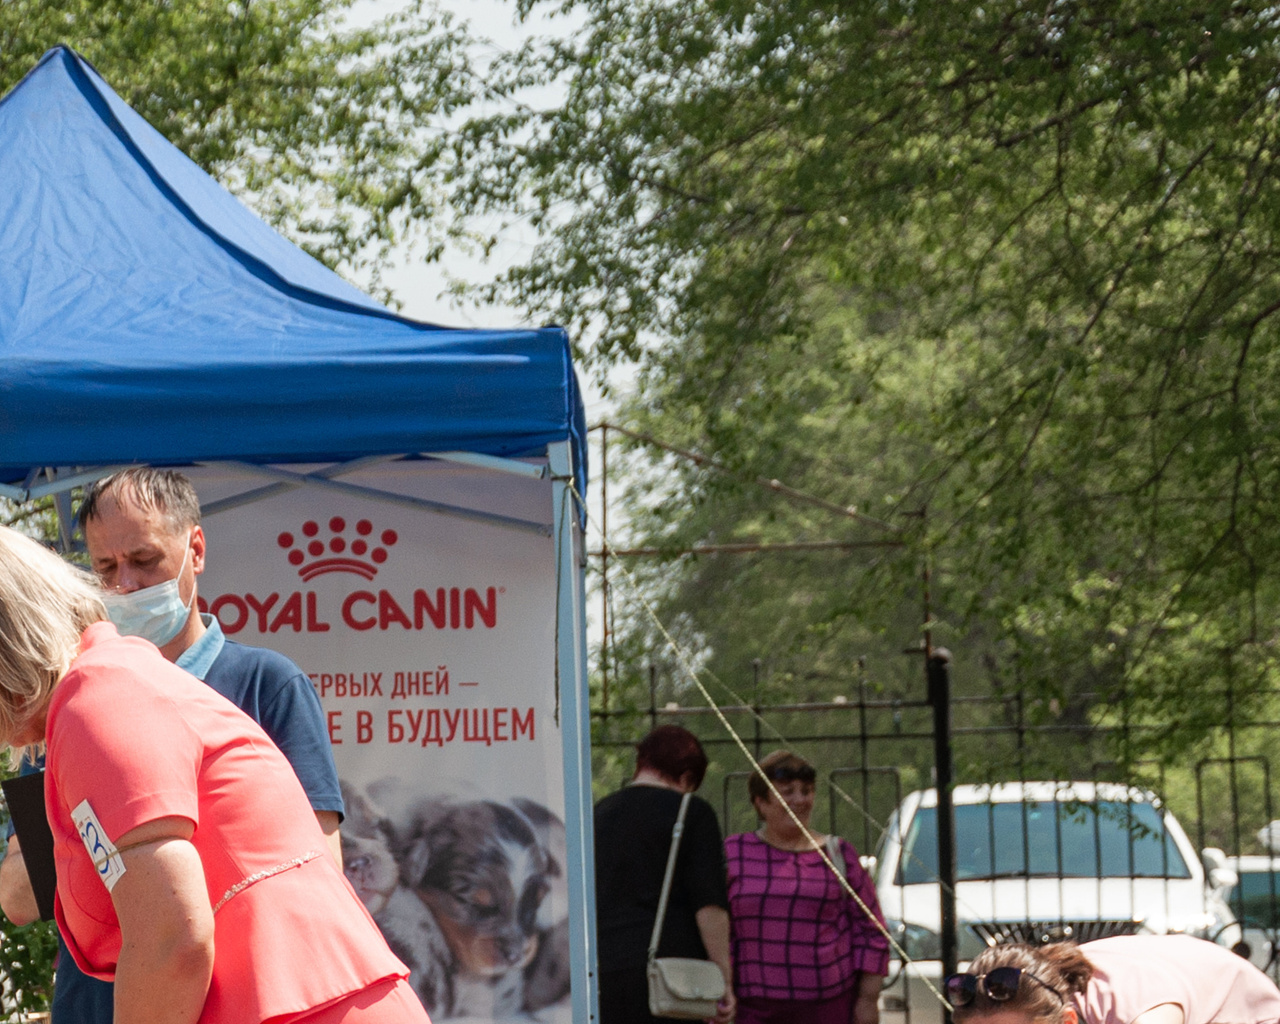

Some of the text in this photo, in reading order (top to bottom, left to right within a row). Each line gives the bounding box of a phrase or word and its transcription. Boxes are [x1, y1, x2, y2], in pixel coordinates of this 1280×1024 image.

[309, 671, 383, 698] РВЫХ
[391, 665, 450, 700] ДНЕЙ
[356, 710, 373, 744] В
[387, 707, 535, 748] БУДУЩЕМ
